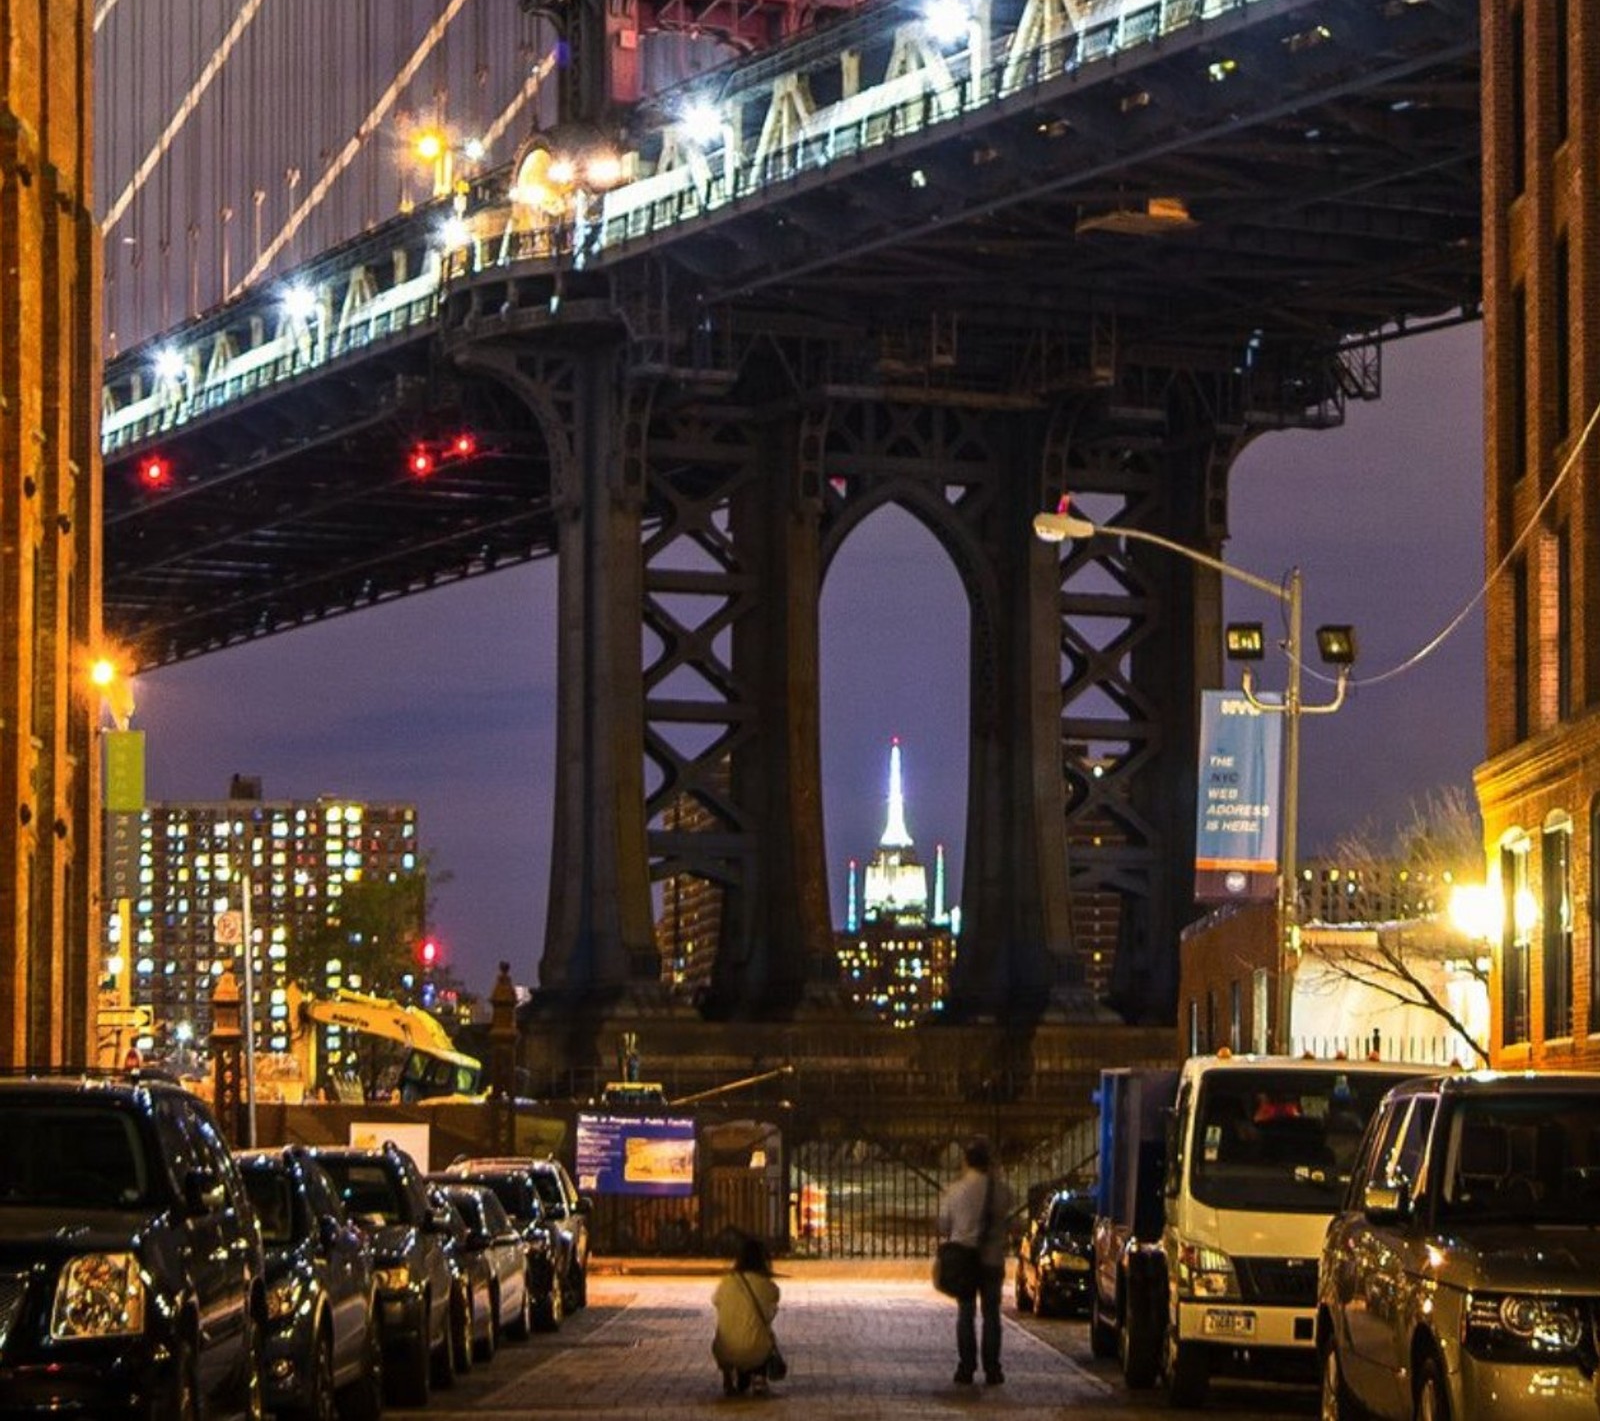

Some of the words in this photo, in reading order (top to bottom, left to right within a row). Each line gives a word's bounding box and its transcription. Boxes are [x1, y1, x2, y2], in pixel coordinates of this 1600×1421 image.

[1210, 755, 1234, 767] THE
[1208, 788, 1239, 799] WEB
[1206, 803, 1270, 817] ADDRESS
[1205, 820, 1219, 831] IS
